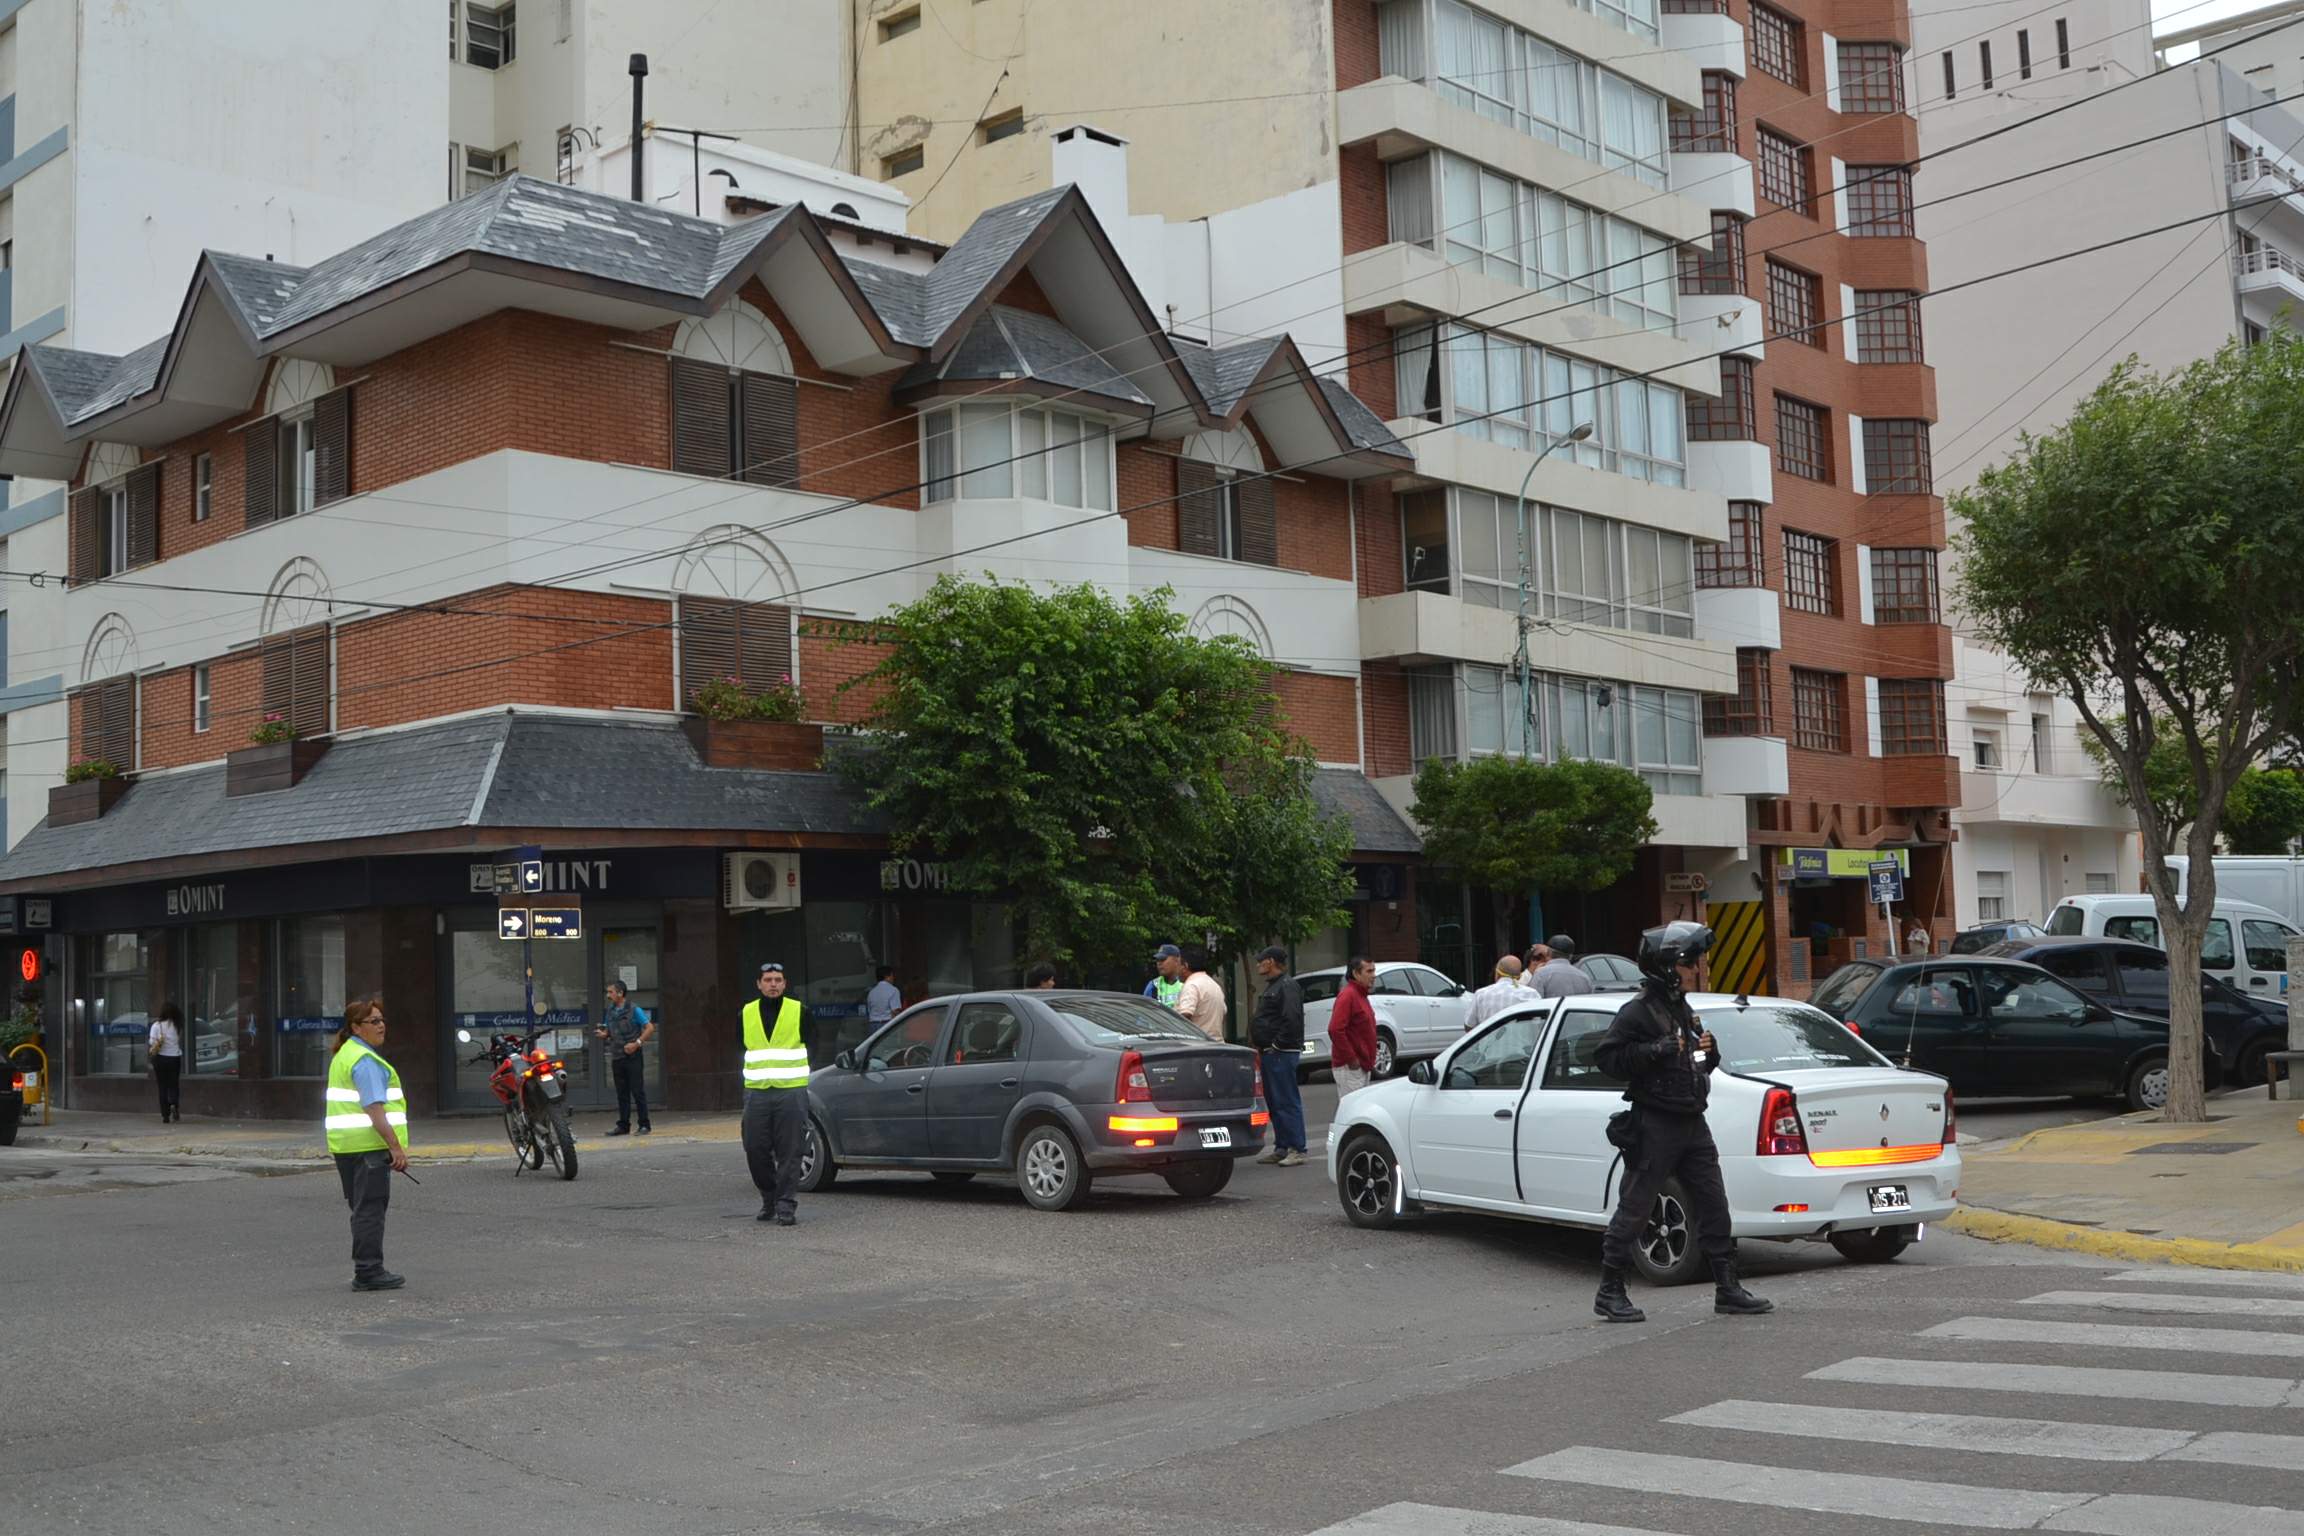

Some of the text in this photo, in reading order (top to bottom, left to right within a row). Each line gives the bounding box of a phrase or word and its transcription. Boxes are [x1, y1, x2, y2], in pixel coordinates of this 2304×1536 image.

[541, 860, 612, 891] MINT
[179, 884, 225, 914] OMINT
[535, 915, 563, 924] Moreno
[545, 1011, 581, 1024] Médica
